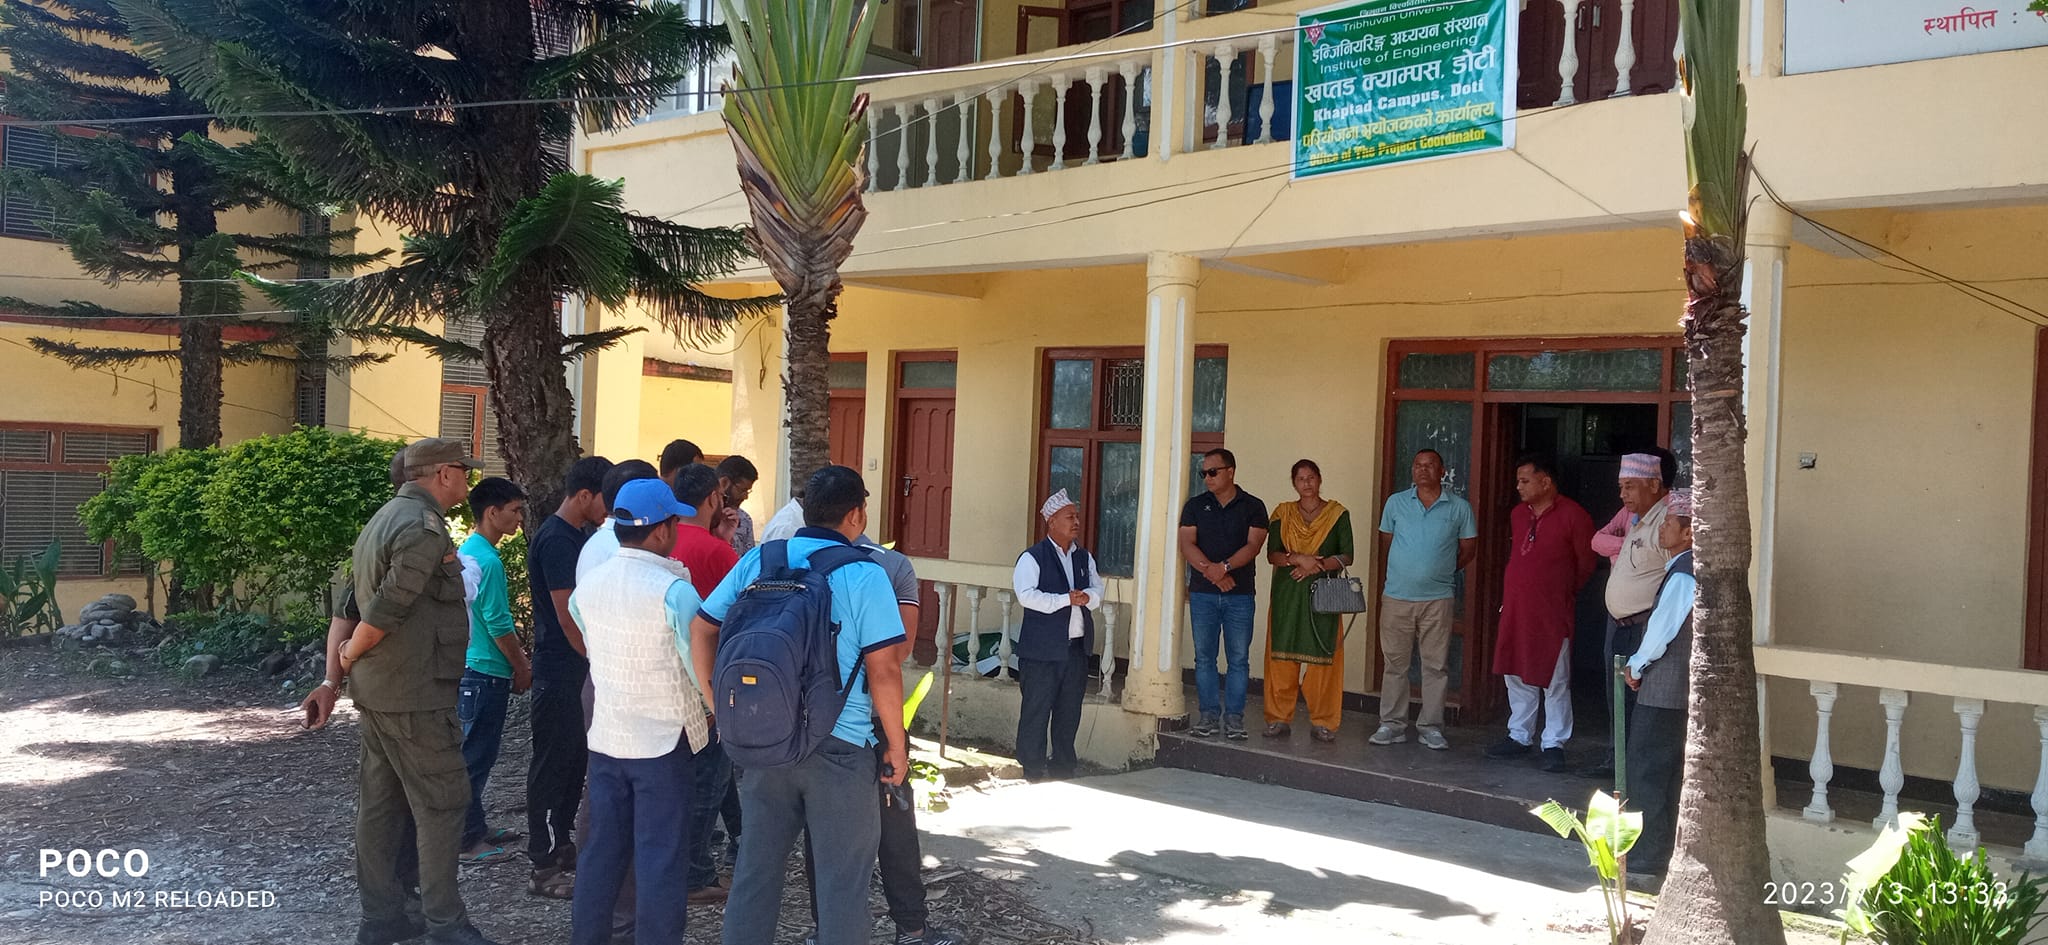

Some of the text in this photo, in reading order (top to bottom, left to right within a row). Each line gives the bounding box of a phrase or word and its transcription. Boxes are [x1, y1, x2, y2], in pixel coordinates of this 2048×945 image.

[1343, 14, 1396, 33] Tribhuvan
[1390, 23, 1440, 47] अध्ययन
[1444, 13, 1489, 36] संस्थान
[1924, 7, 1998, 35] स्थापित
[1320, 34, 1478, 74] Institute of Engineering
[1304, 77, 1357, 104] खप्तड
[1452, 44, 1496, 75] डोटी
[1313, 79, 1484, 122] Khaptad Campus, Doti
[1436, 101, 1495, 121] कार्यालय
[1309, 128, 1487, 166] Office of The Project Coordinator
